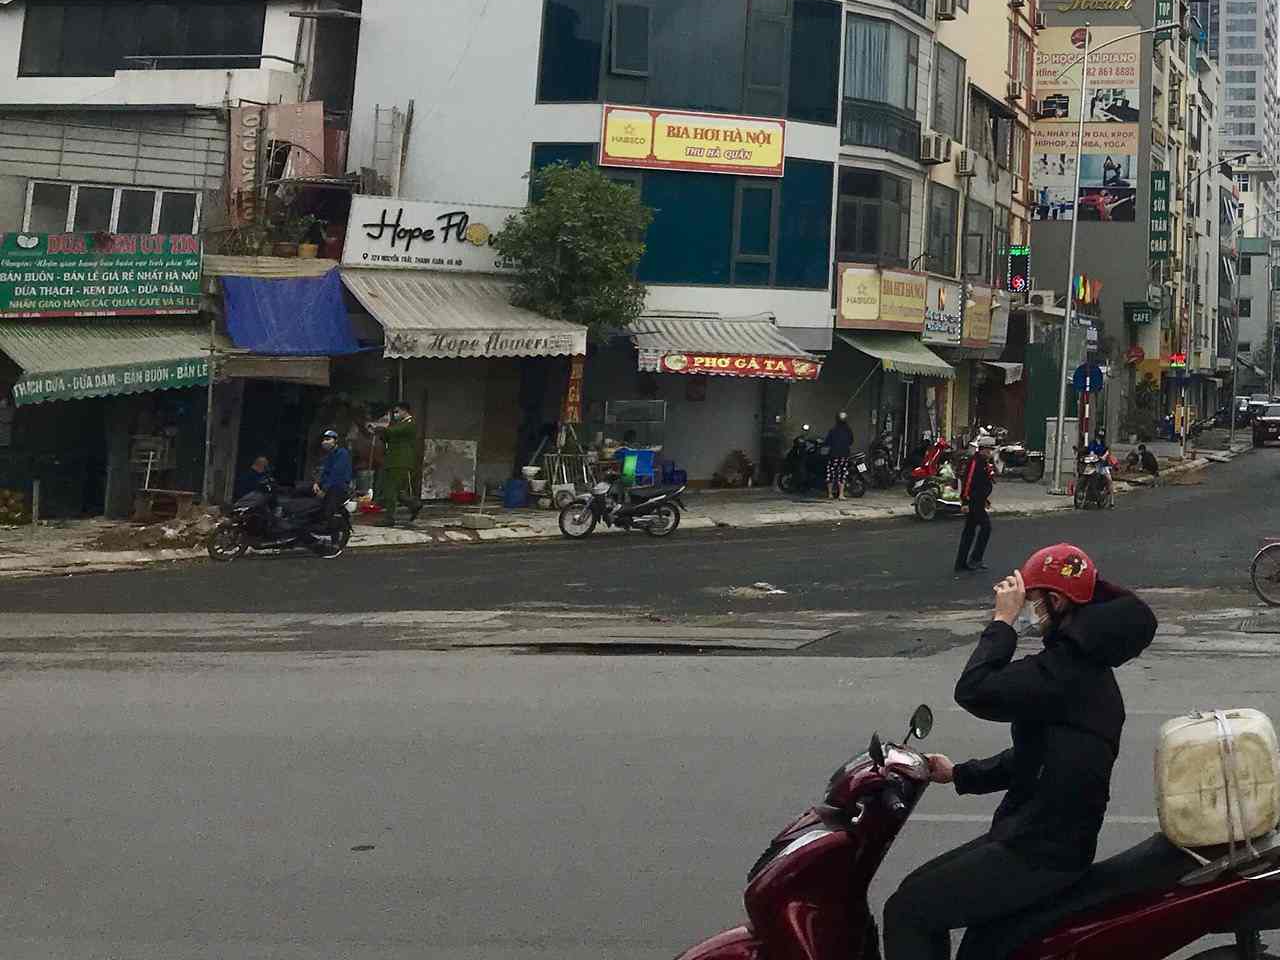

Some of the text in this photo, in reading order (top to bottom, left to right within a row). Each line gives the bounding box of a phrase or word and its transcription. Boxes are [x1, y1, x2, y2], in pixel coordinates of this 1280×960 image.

[1159, 2, 1171, 17] TOP
[1102, 53, 1136, 64] PIANO
[666, 125, 772, 148] BIA HƠI HÀ NỘI
[362, 207, 436, 252] Hope
[40, 285, 73, 297] THẠCH
[83, 285, 106, 296] KEM
[428, 332, 480, 355] Hope
[485, 332, 550, 355] flowers
[177, 363, 196, 379] BÁN
[763, 359, 788, 372] TA
